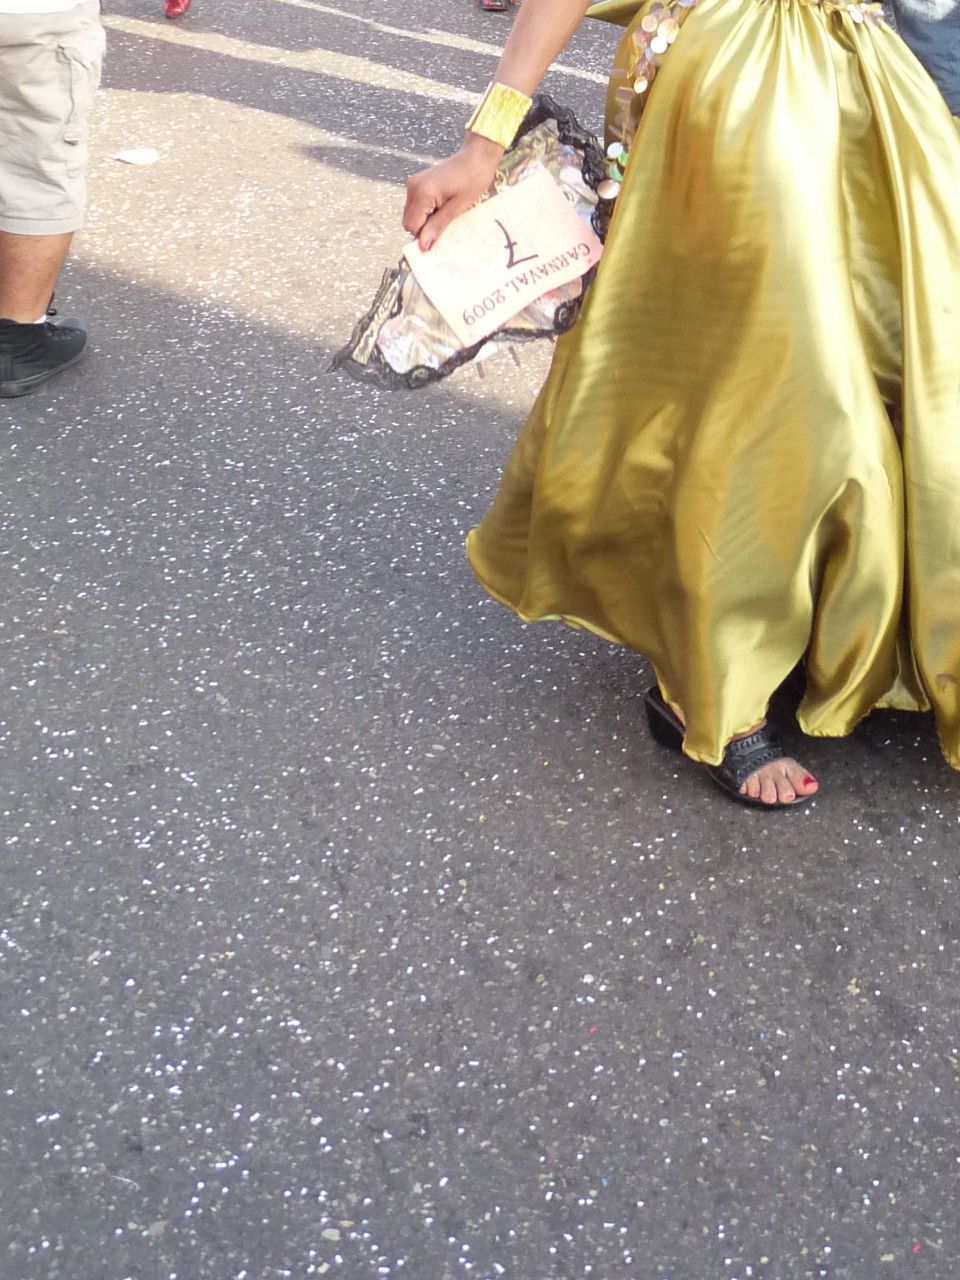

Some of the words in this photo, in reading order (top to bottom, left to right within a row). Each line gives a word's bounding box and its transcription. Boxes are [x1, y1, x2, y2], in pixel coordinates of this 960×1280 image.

[494, 218, 539, 269] 7
[506, 243, 590, 292] CARNAVAL
[462, 287, 506, 326] 2009
